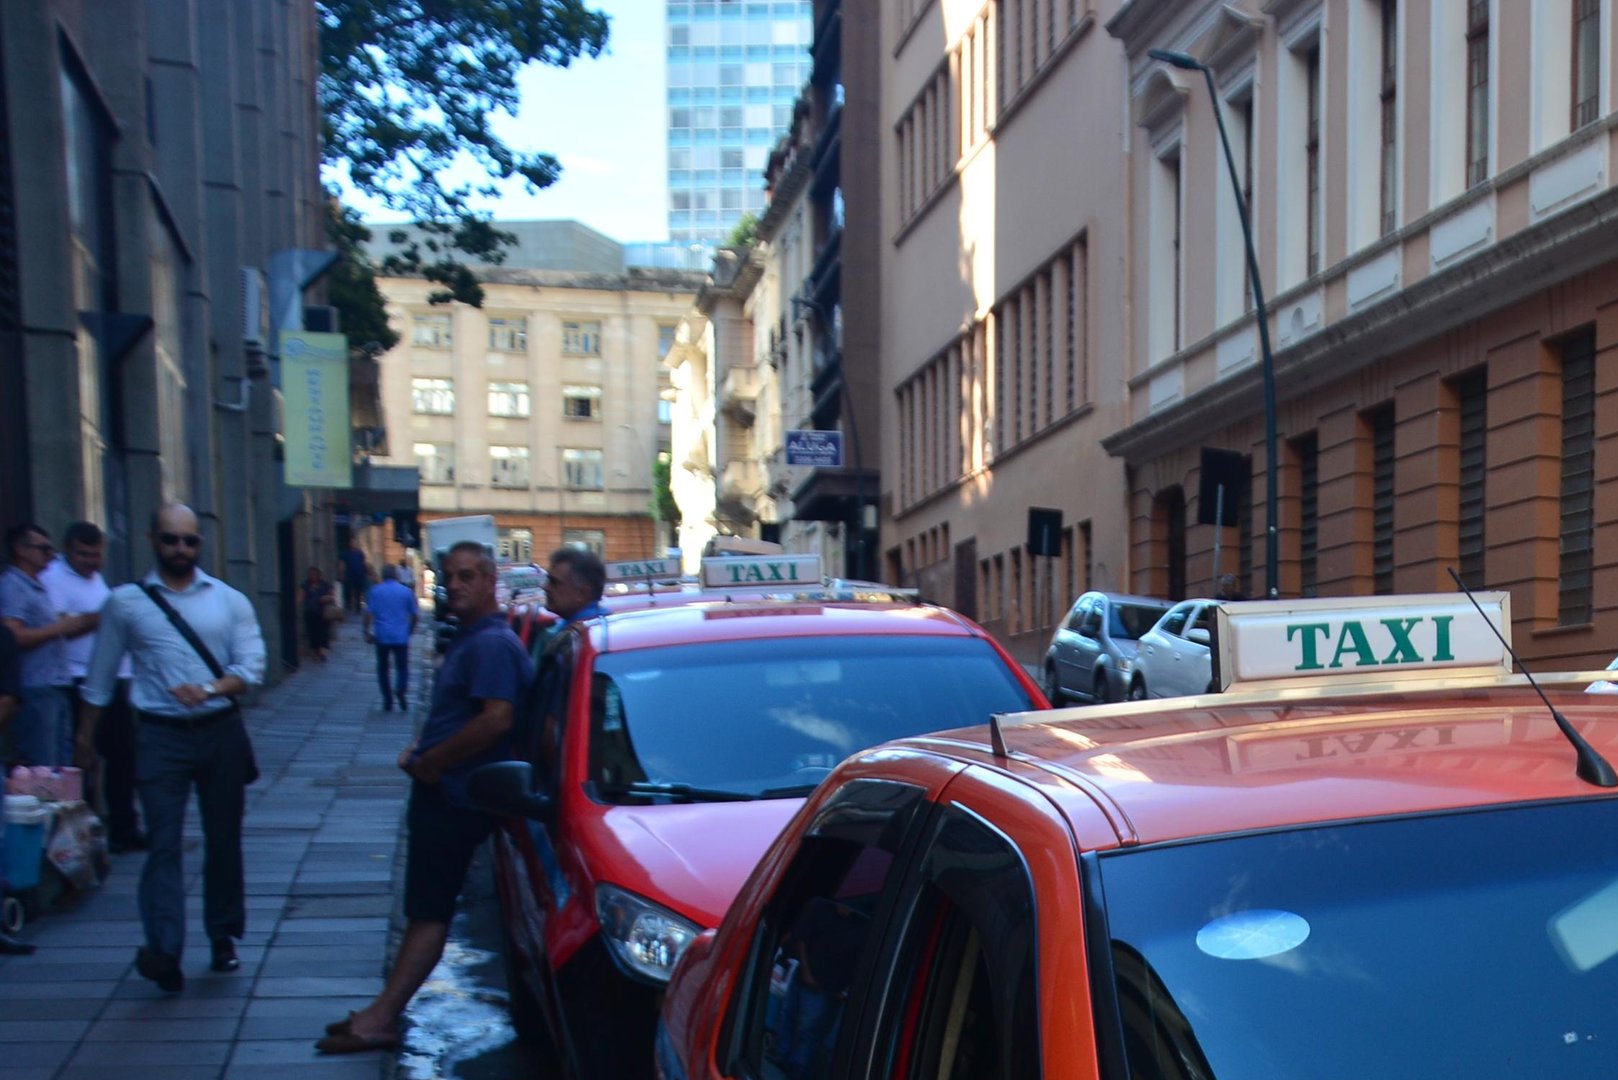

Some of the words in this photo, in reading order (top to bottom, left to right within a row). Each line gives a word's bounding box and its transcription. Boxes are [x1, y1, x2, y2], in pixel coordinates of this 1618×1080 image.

[616, 561, 667, 577] TAXI
[726, 562, 799, 583] TAXI
[1286, 615, 1455, 671] TAXI
